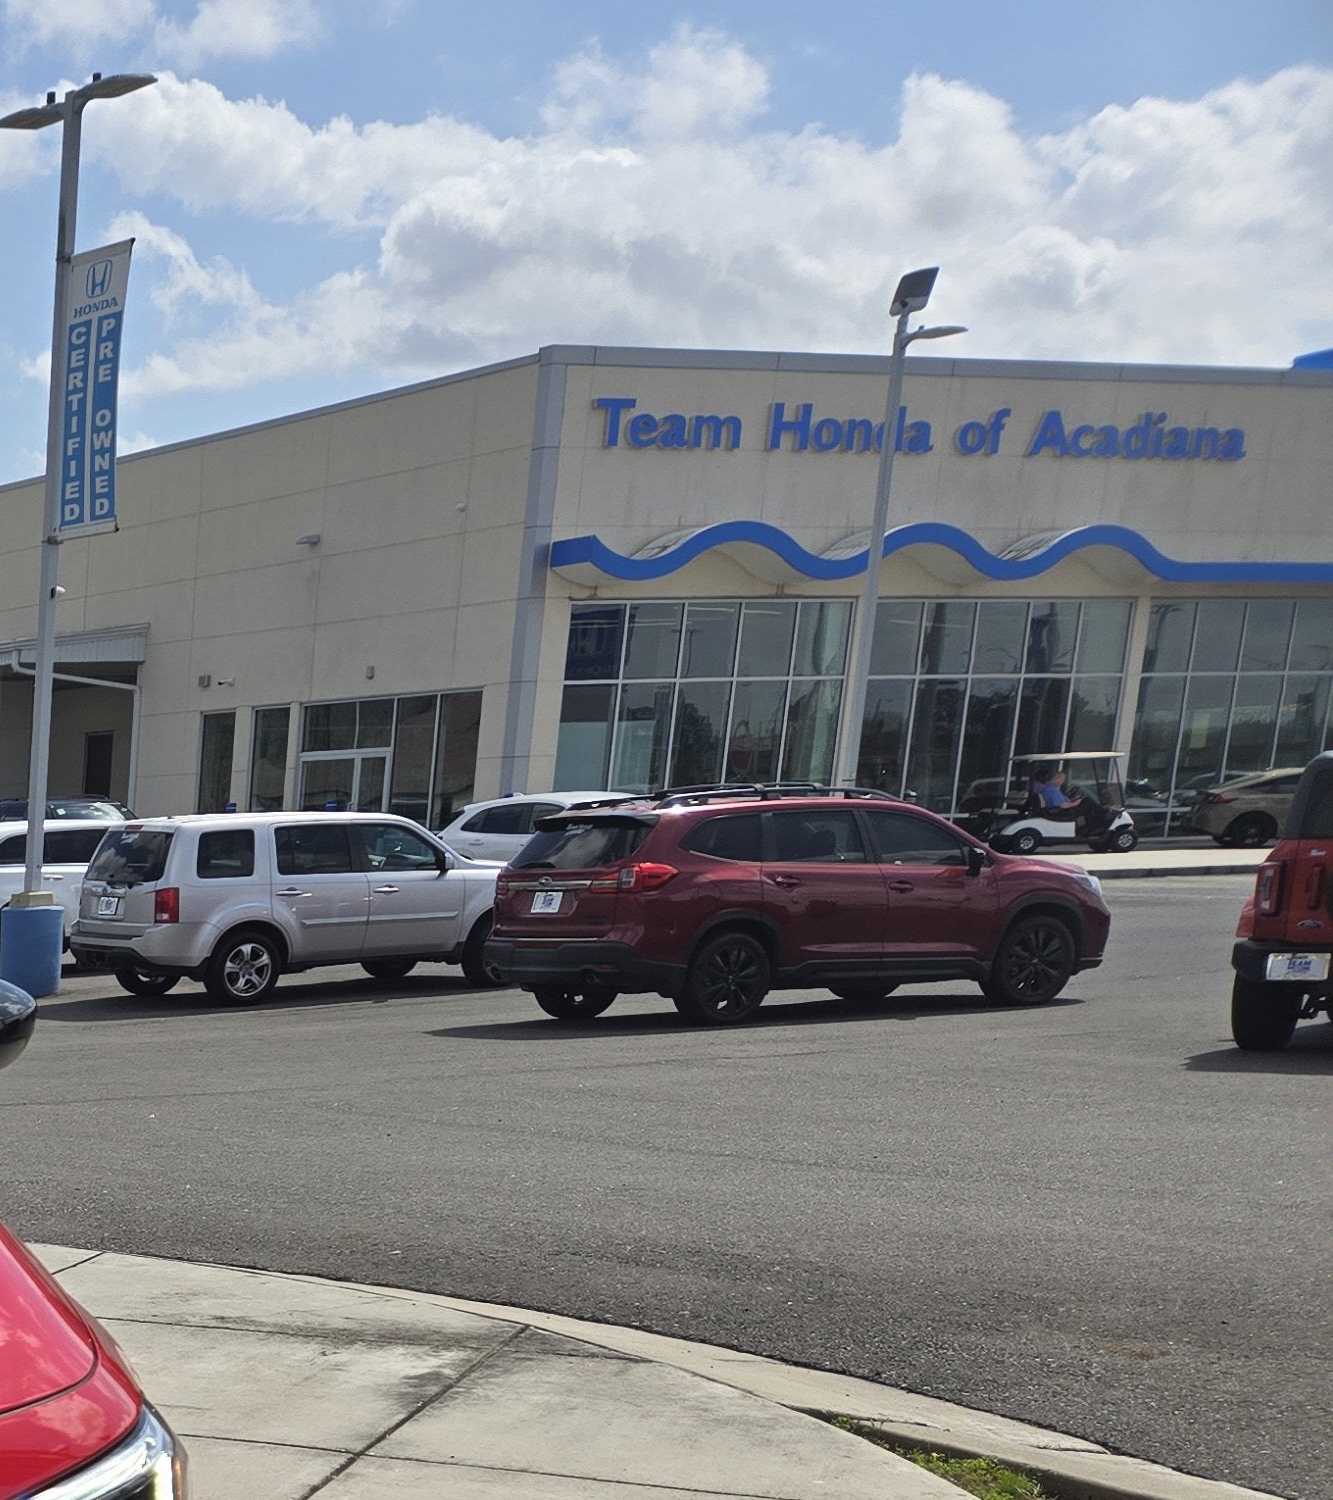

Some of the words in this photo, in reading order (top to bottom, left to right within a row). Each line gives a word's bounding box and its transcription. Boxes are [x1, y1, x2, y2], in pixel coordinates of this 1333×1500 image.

[73, 297, 118, 318] HONDA
[98, 317, 116, 383] PRE
[64, 326, 87, 521] CERTIFIED
[596, 397, 743, 449] Team
[769, 402, 934, 453] Honda
[958, 408, 1011, 454] of
[1031, 410, 1247, 461] Acadiana
[92, 409, 113, 516] OWNED
